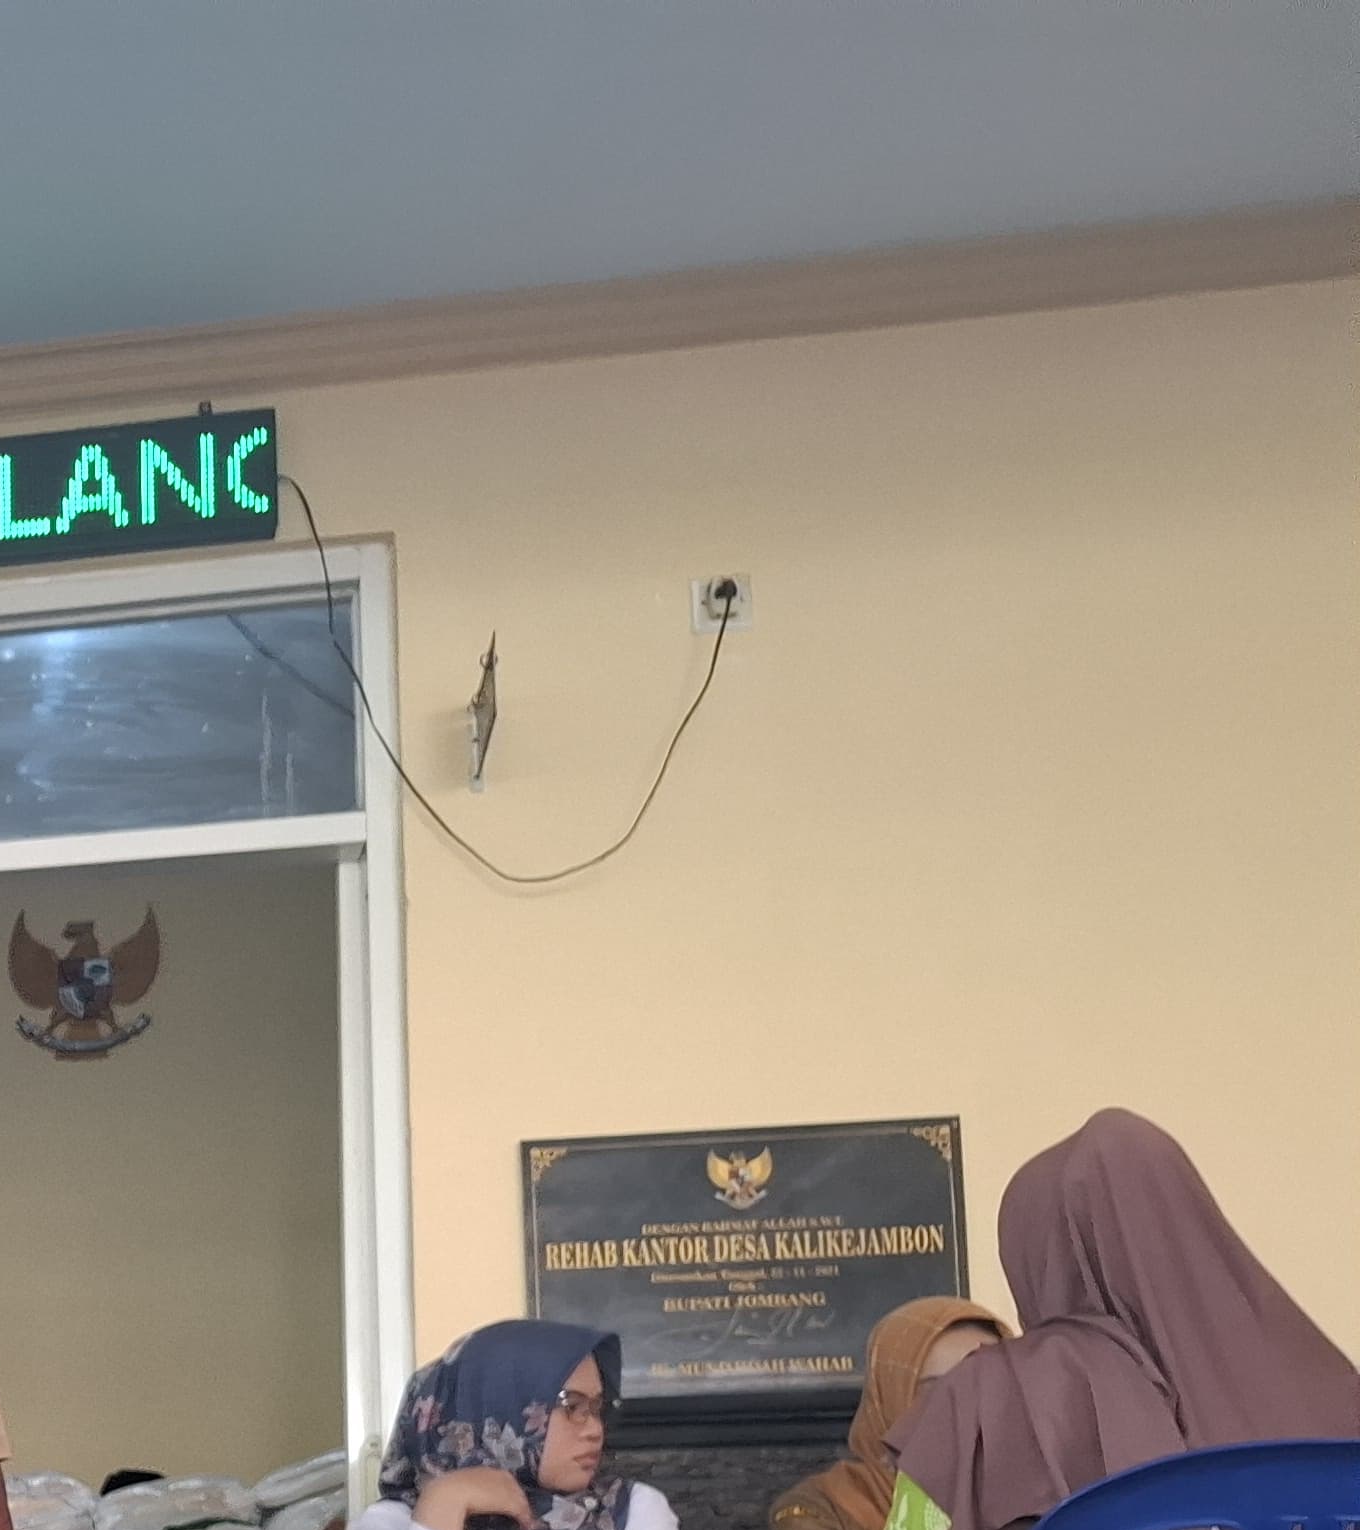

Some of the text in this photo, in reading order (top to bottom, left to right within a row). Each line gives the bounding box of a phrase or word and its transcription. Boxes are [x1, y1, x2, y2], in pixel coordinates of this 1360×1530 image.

[545, 1223, 944, 1271] REHAB KANTOR DESA KALIKEJAMBON
